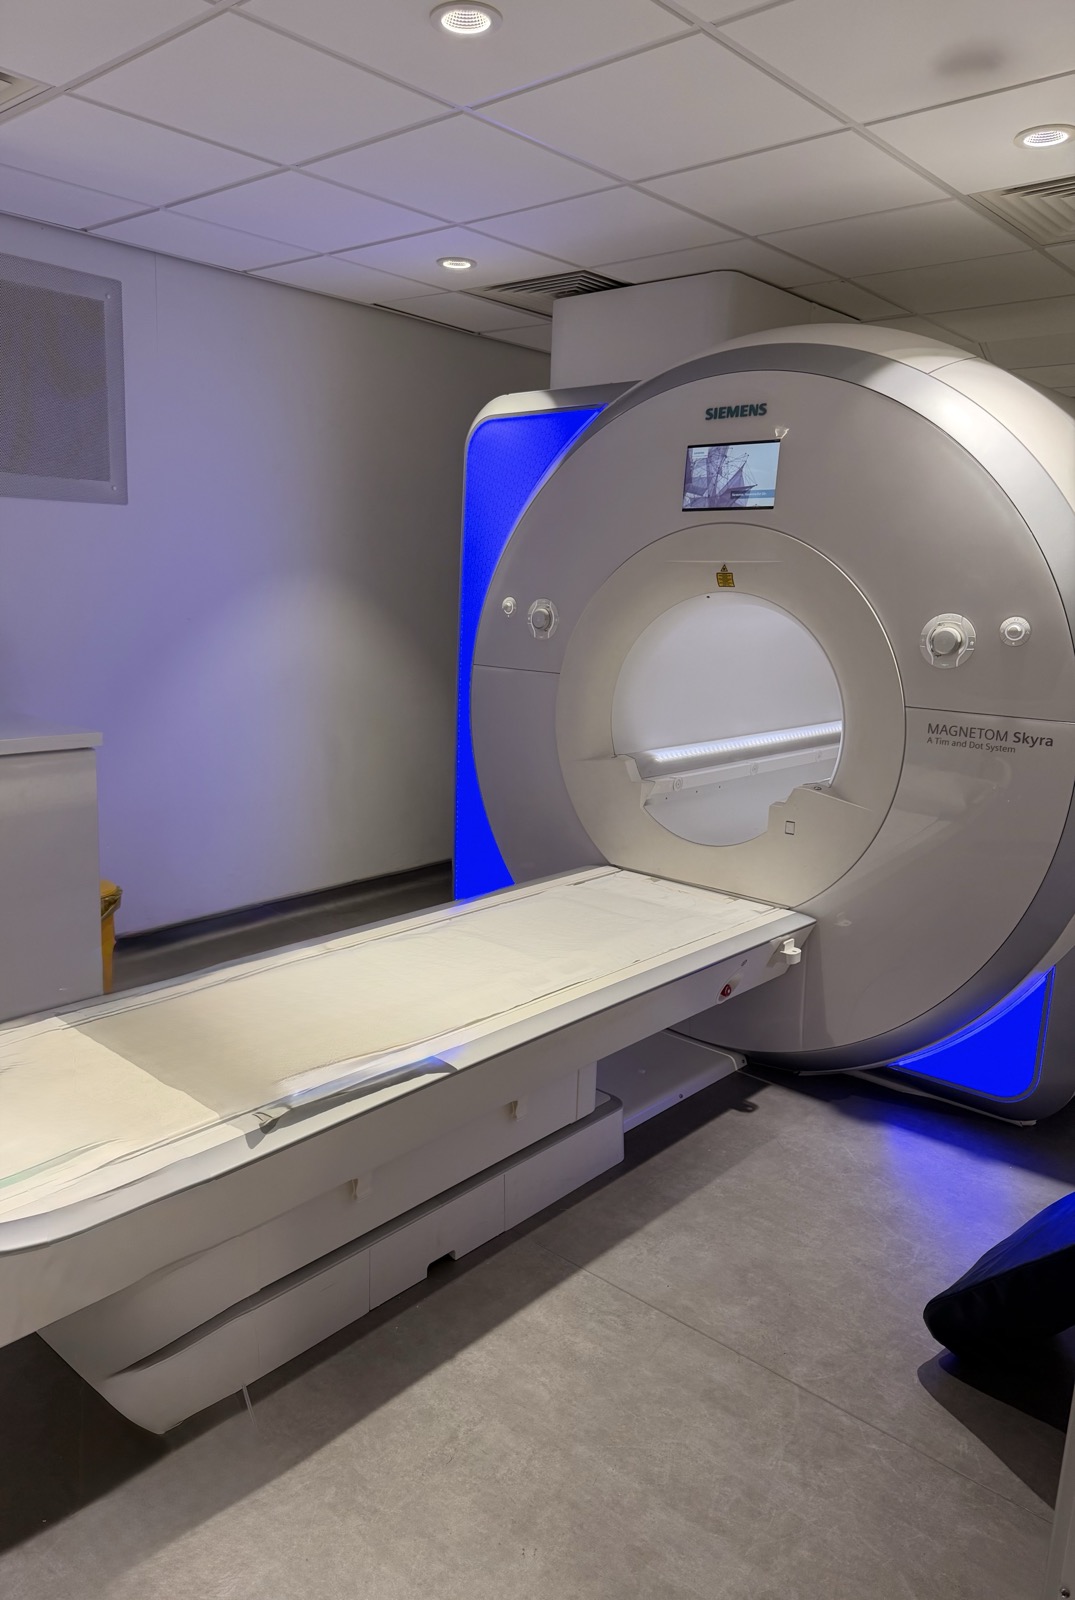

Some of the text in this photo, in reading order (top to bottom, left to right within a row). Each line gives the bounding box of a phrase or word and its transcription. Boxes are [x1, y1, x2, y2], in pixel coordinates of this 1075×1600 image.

[705, 402, 768, 421] SIEMENS
[926, 736, 1016, 753] A Tim and Dot System
[927, 722, 1054, 748] MAGNETOM Skyra
